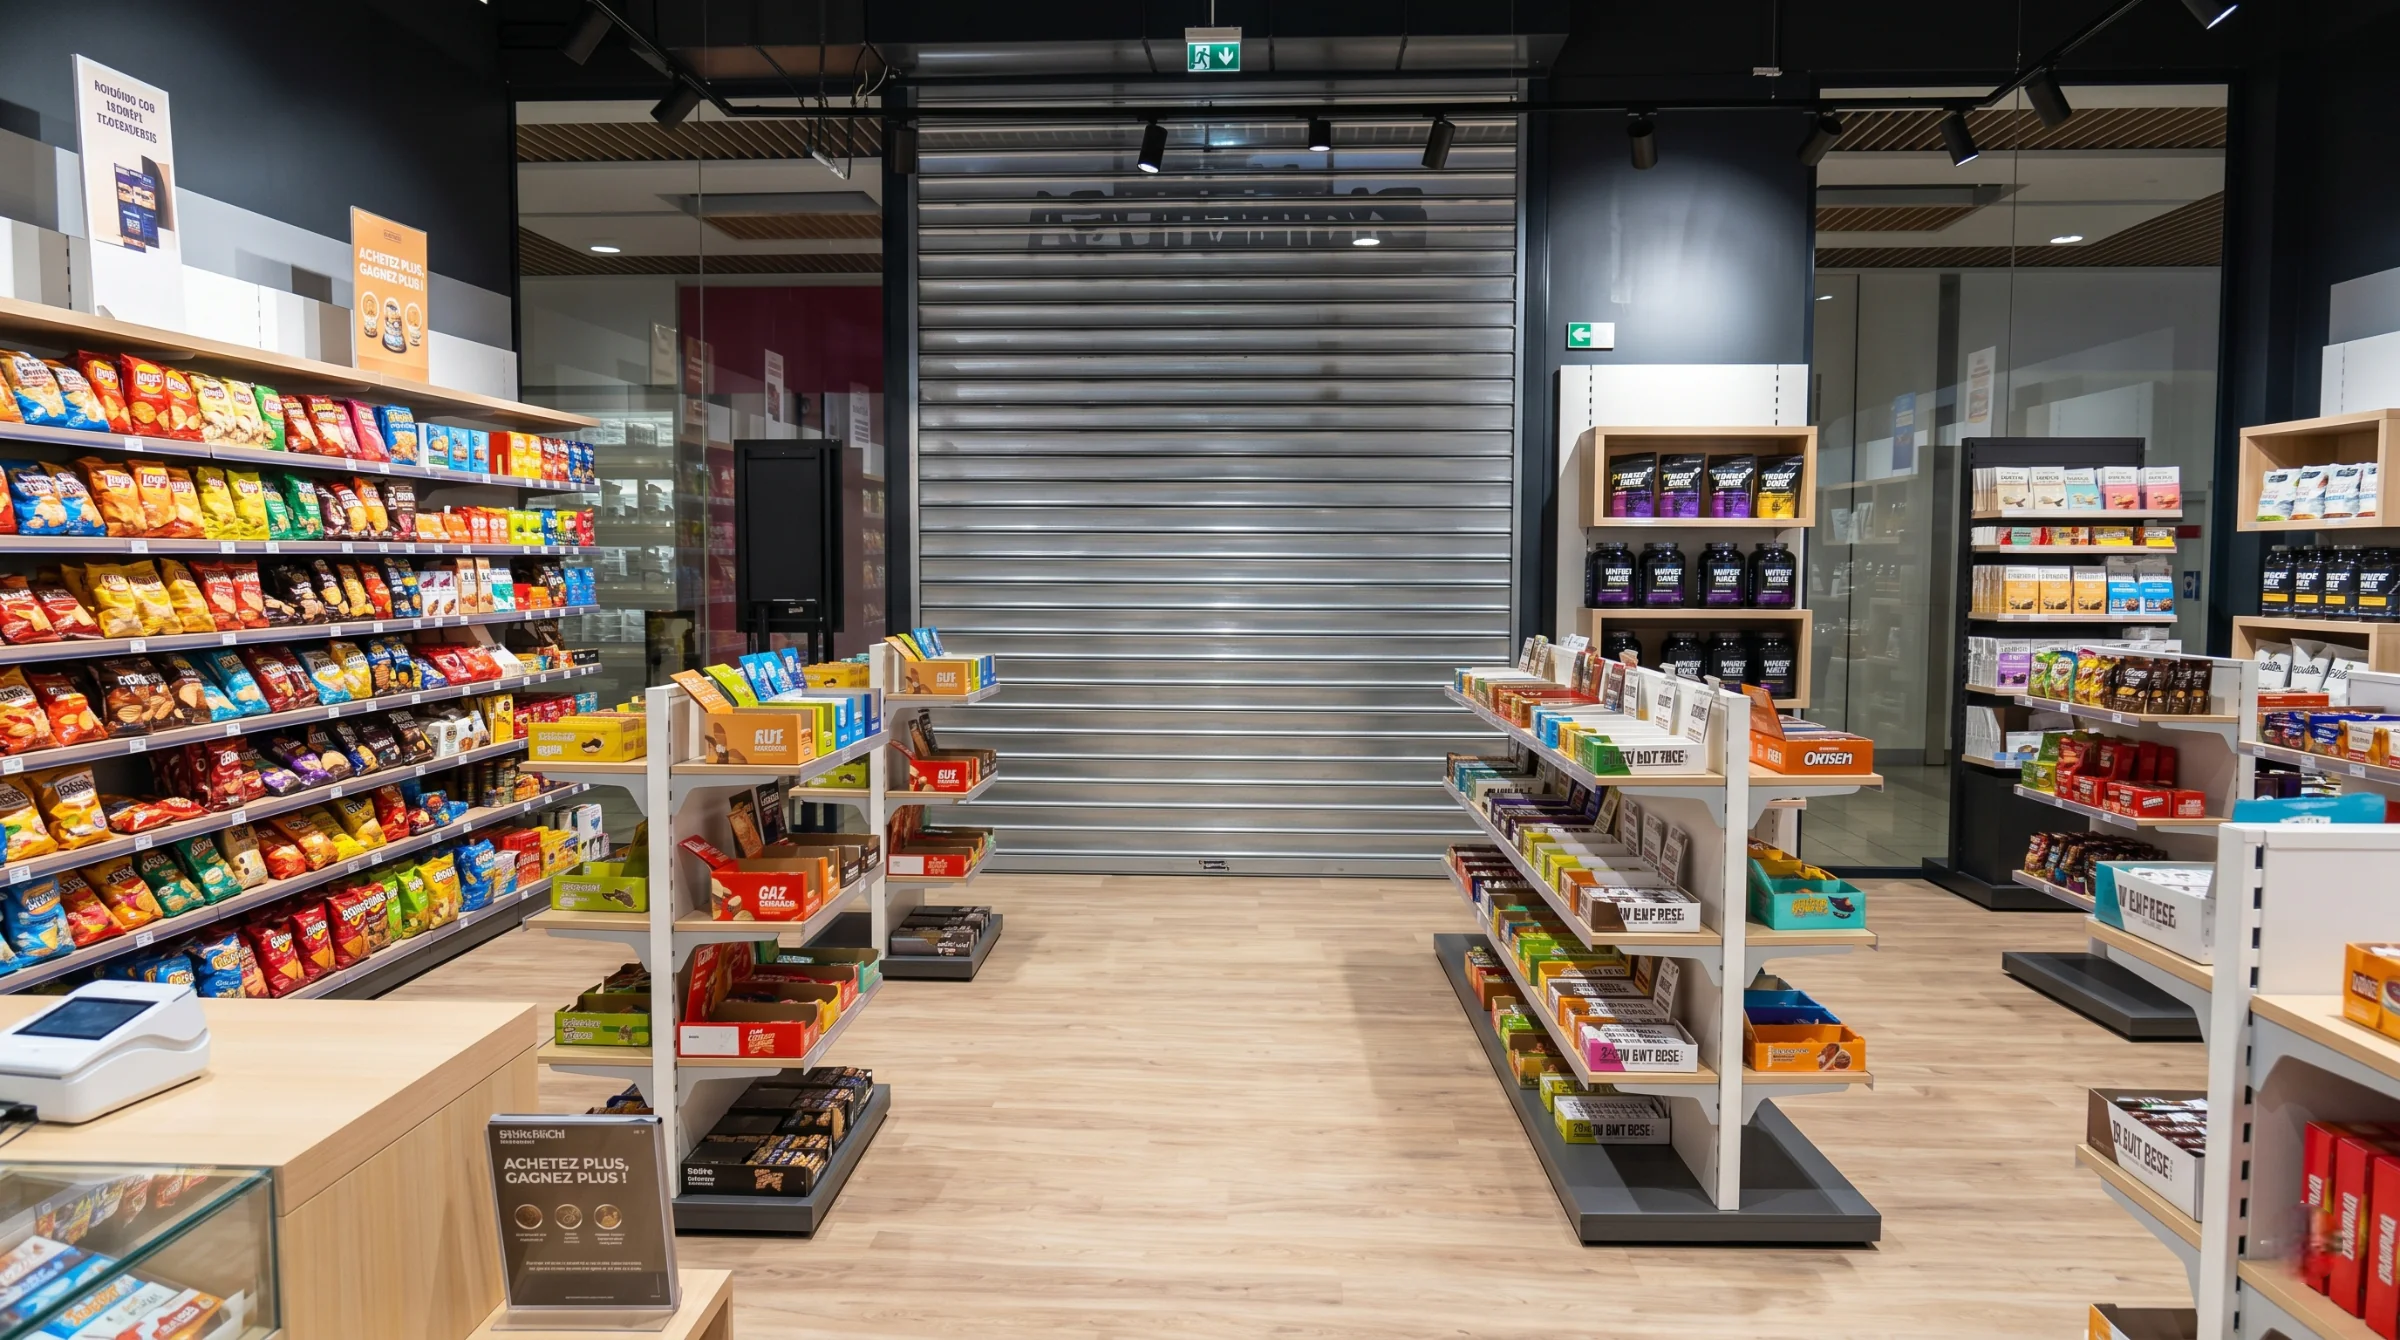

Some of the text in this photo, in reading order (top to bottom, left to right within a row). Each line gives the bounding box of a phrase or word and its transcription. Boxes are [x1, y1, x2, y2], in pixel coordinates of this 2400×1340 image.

[359, 247, 425, 279] ACHETEZ PLUS,
[359, 262, 398, 284] GAGNEZ
[503, 1157, 630, 1172] ACHETEZ PLUS,
[505, 1171, 574, 1184] GAGNEZ
[577, 1171, 619, 1184] PLUS
